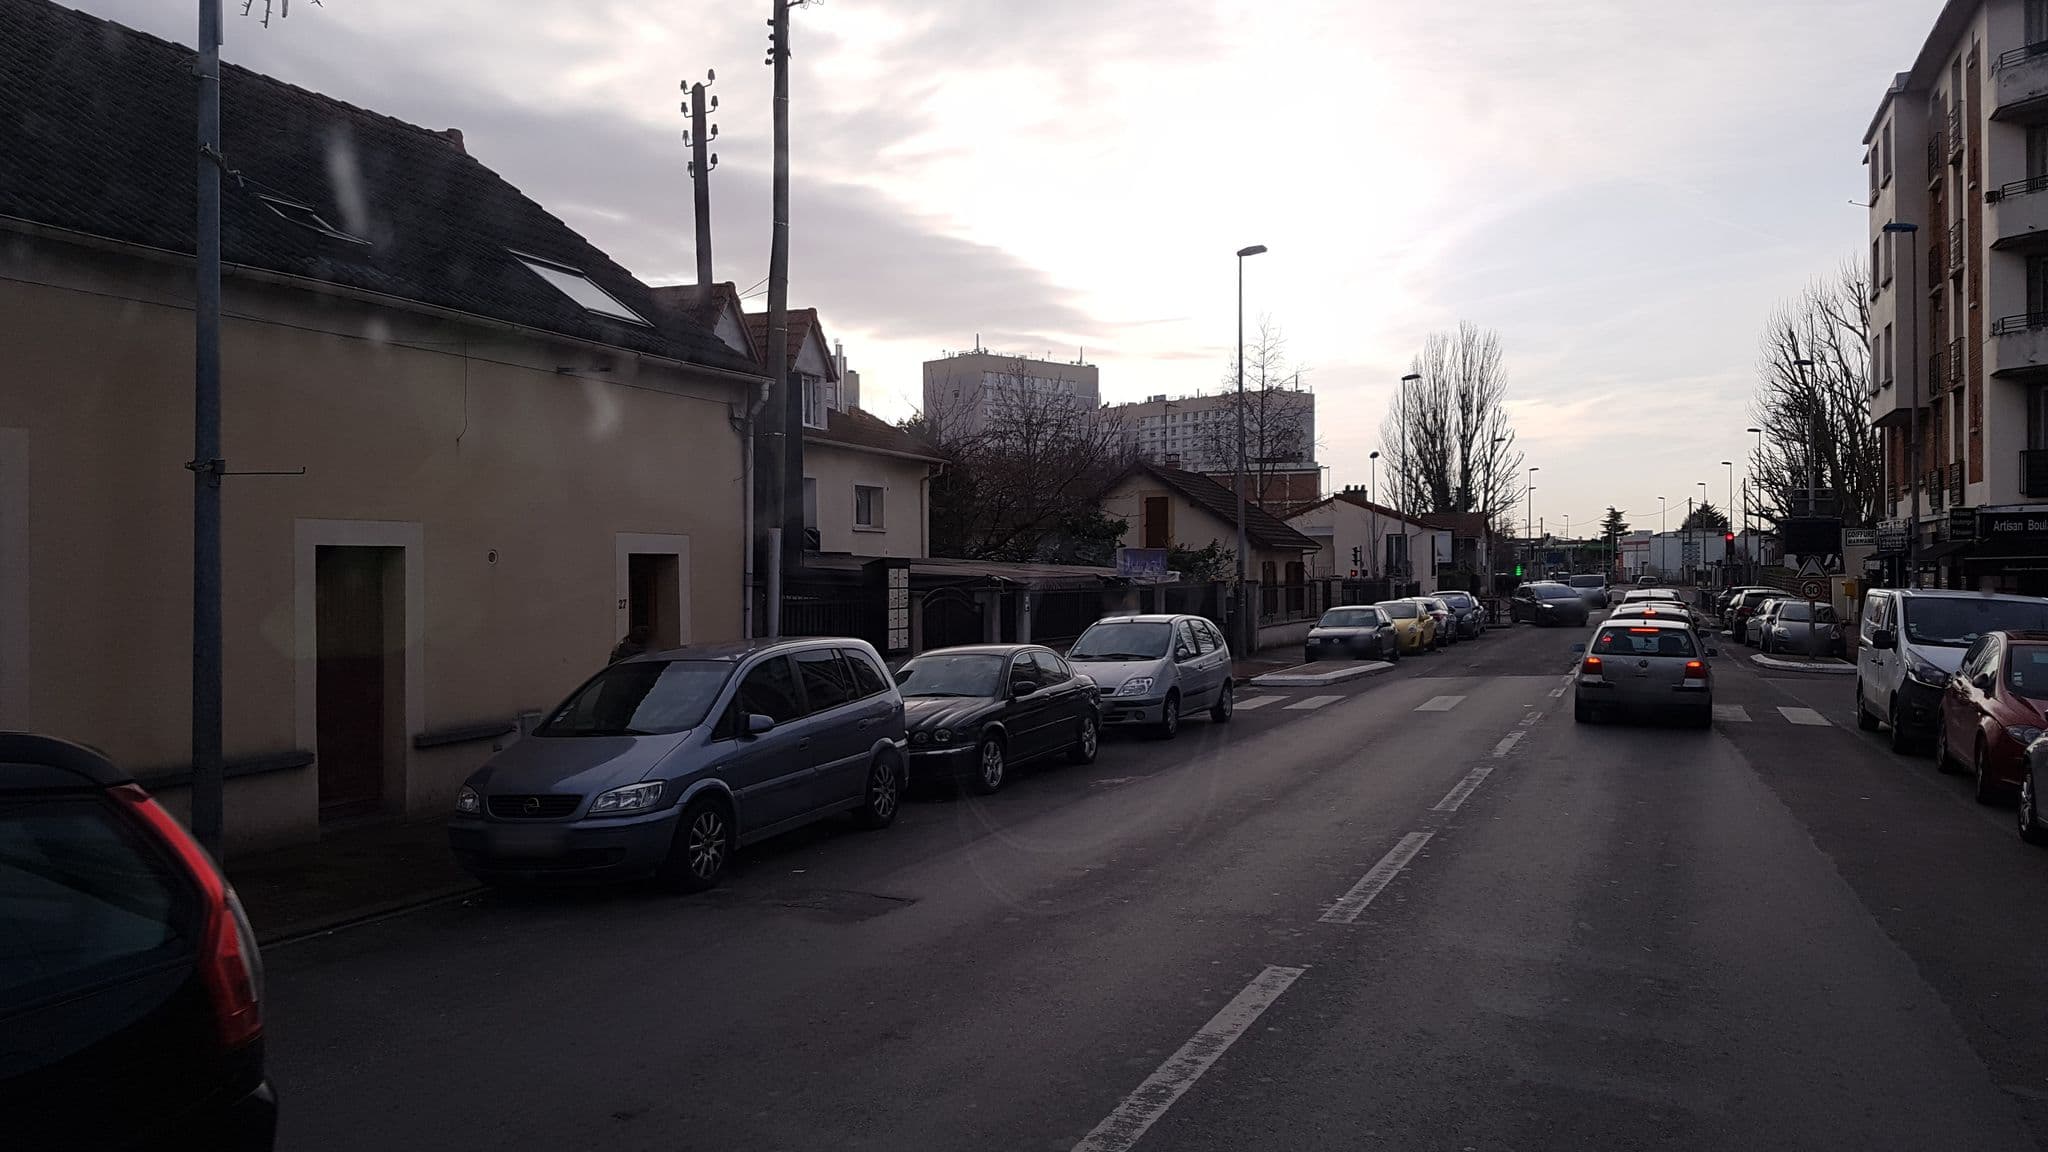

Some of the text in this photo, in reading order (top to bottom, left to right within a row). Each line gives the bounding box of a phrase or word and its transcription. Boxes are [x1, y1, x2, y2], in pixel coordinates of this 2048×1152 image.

[1993, 519, 2023, 531] Artisan
[1848, 530, 1875, 538] COIFFURE
[1807, 585, 1819, 595] 30
[618, 599, 627, 610] 27
